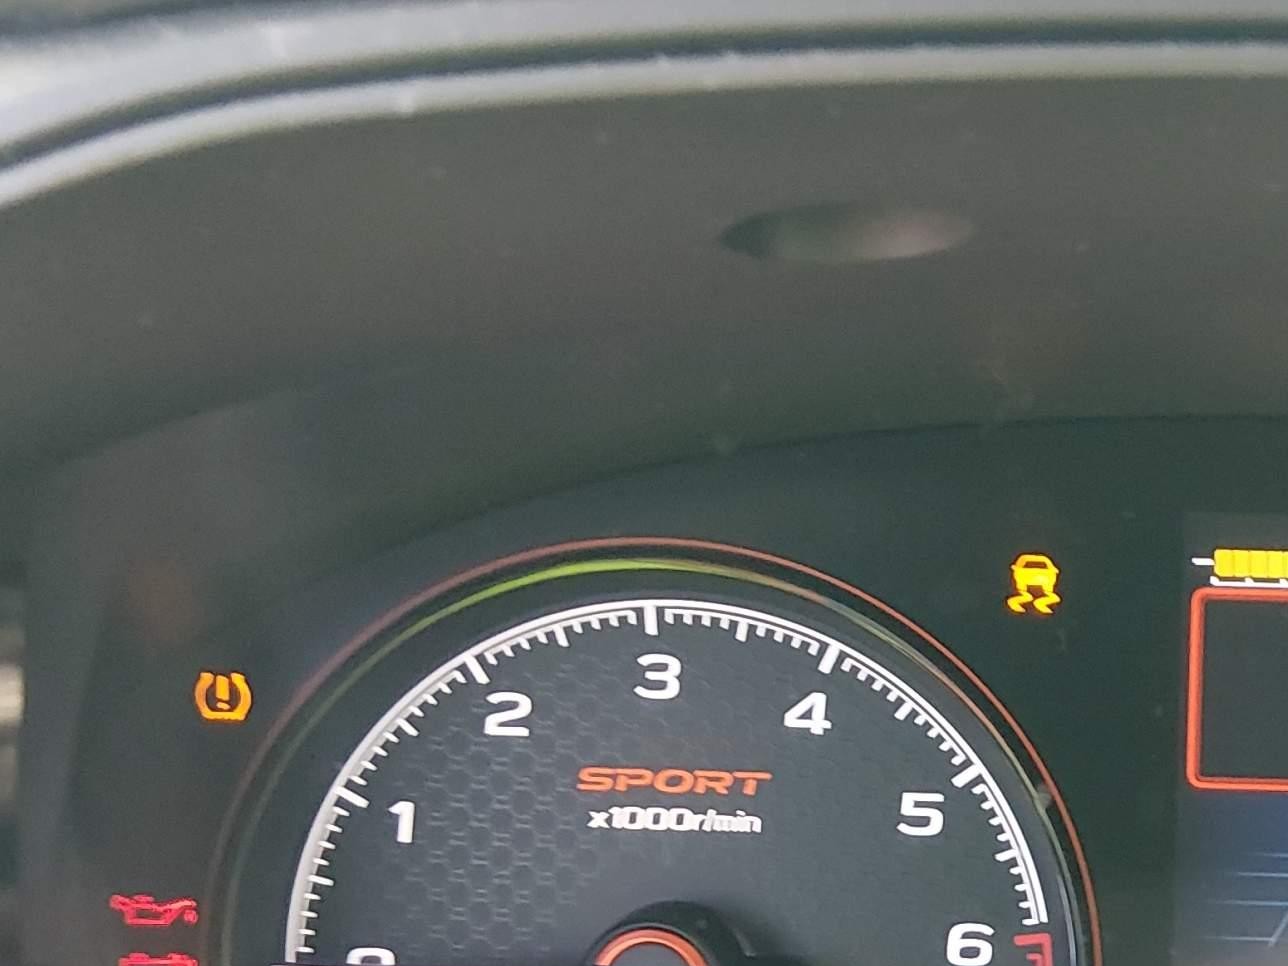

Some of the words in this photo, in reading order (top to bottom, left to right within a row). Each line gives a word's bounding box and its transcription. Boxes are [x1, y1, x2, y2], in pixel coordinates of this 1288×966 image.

[633, 653, 682, 700] 3
[483, 691, 532, 737] 2
[783, 692, 832, 735] 4
[576, 767, 772, 796] SPORT
[388, 800, 415, 844] 1
[896, 792, 945, 836] 5
[946, 922, 995, 966] 6
